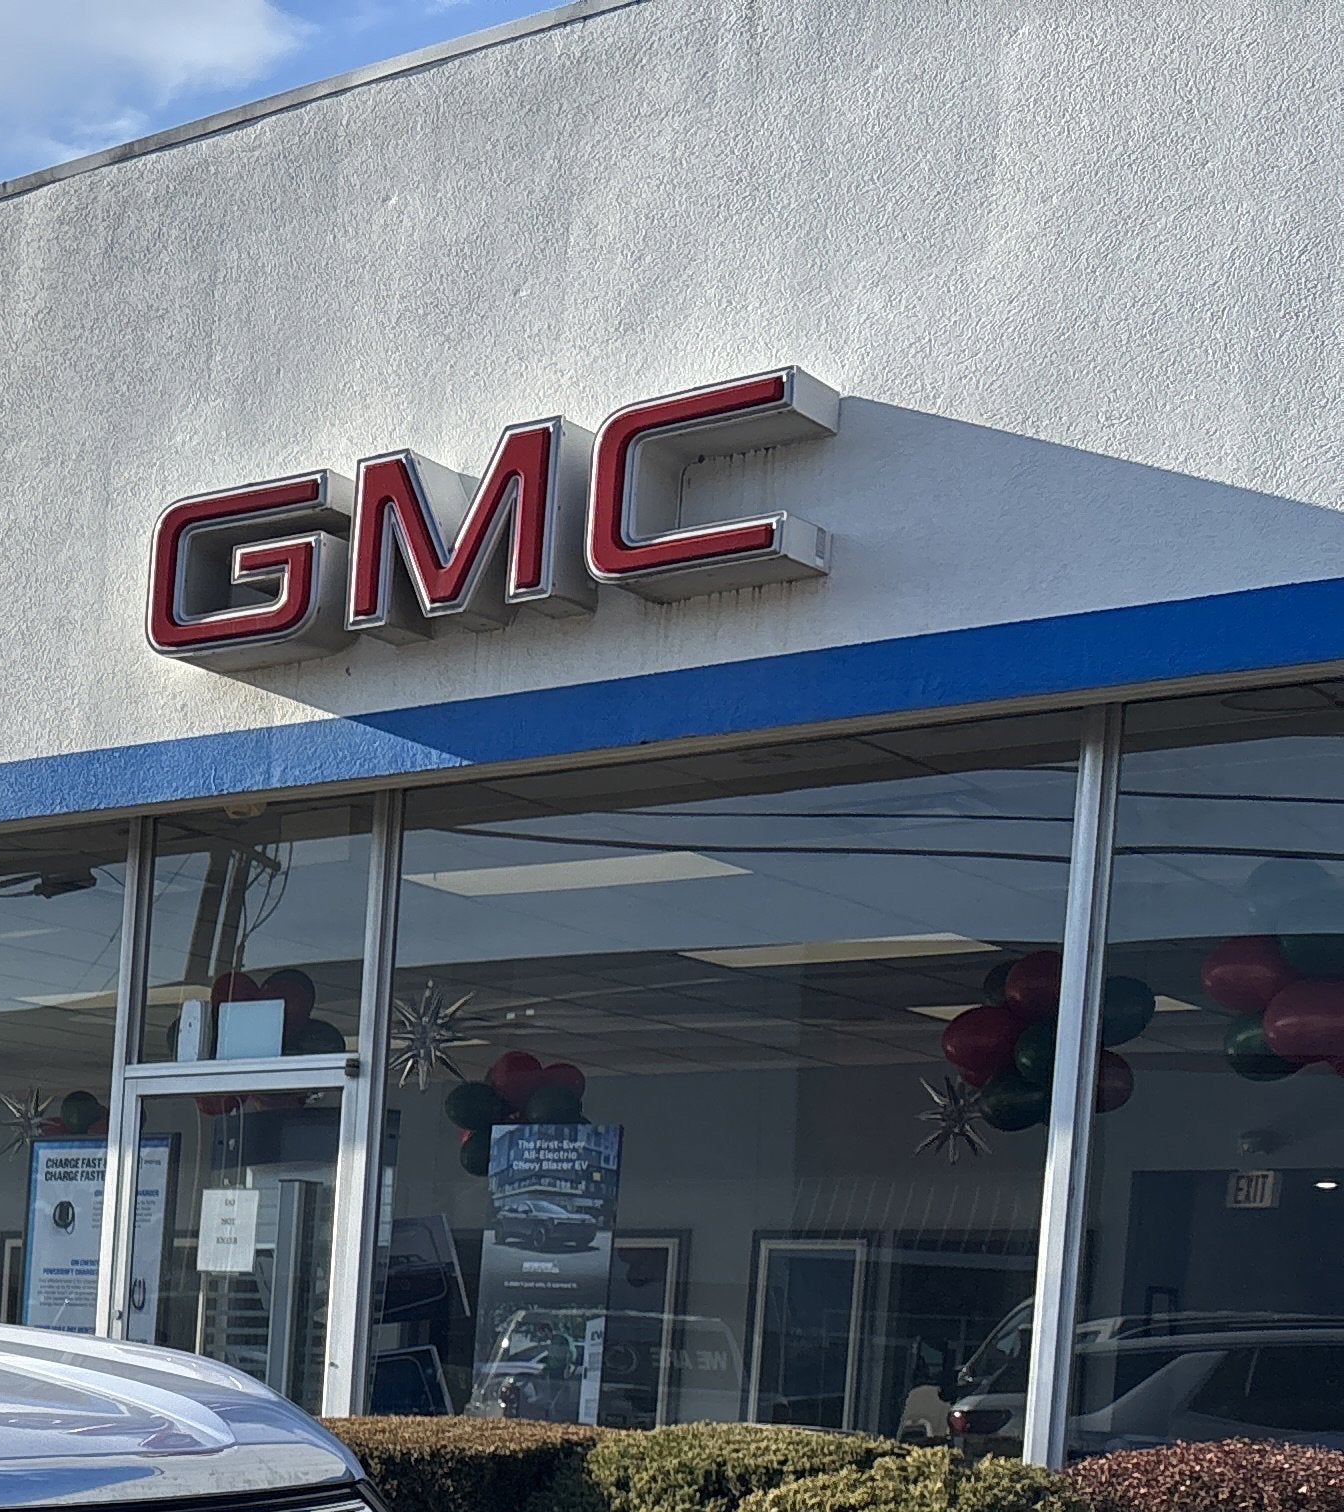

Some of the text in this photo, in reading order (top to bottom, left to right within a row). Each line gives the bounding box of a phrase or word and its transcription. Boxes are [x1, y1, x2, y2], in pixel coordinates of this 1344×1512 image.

[146, 364, 812, 658] GMC
[518, 1139, 586, 1150] The First-Ever
[523, 1150, 578, 1160] All-Electric
[45, 1157, 80, 1169] CHARGE
[81, 1157, 103, 1169] FAST
[512, 1160, 589, 1171] Chevy Blazer EV
[44, 1169, 106, 1182] CHARGE FASTE
[1233, 1174, 1269, 1204] EXIT
